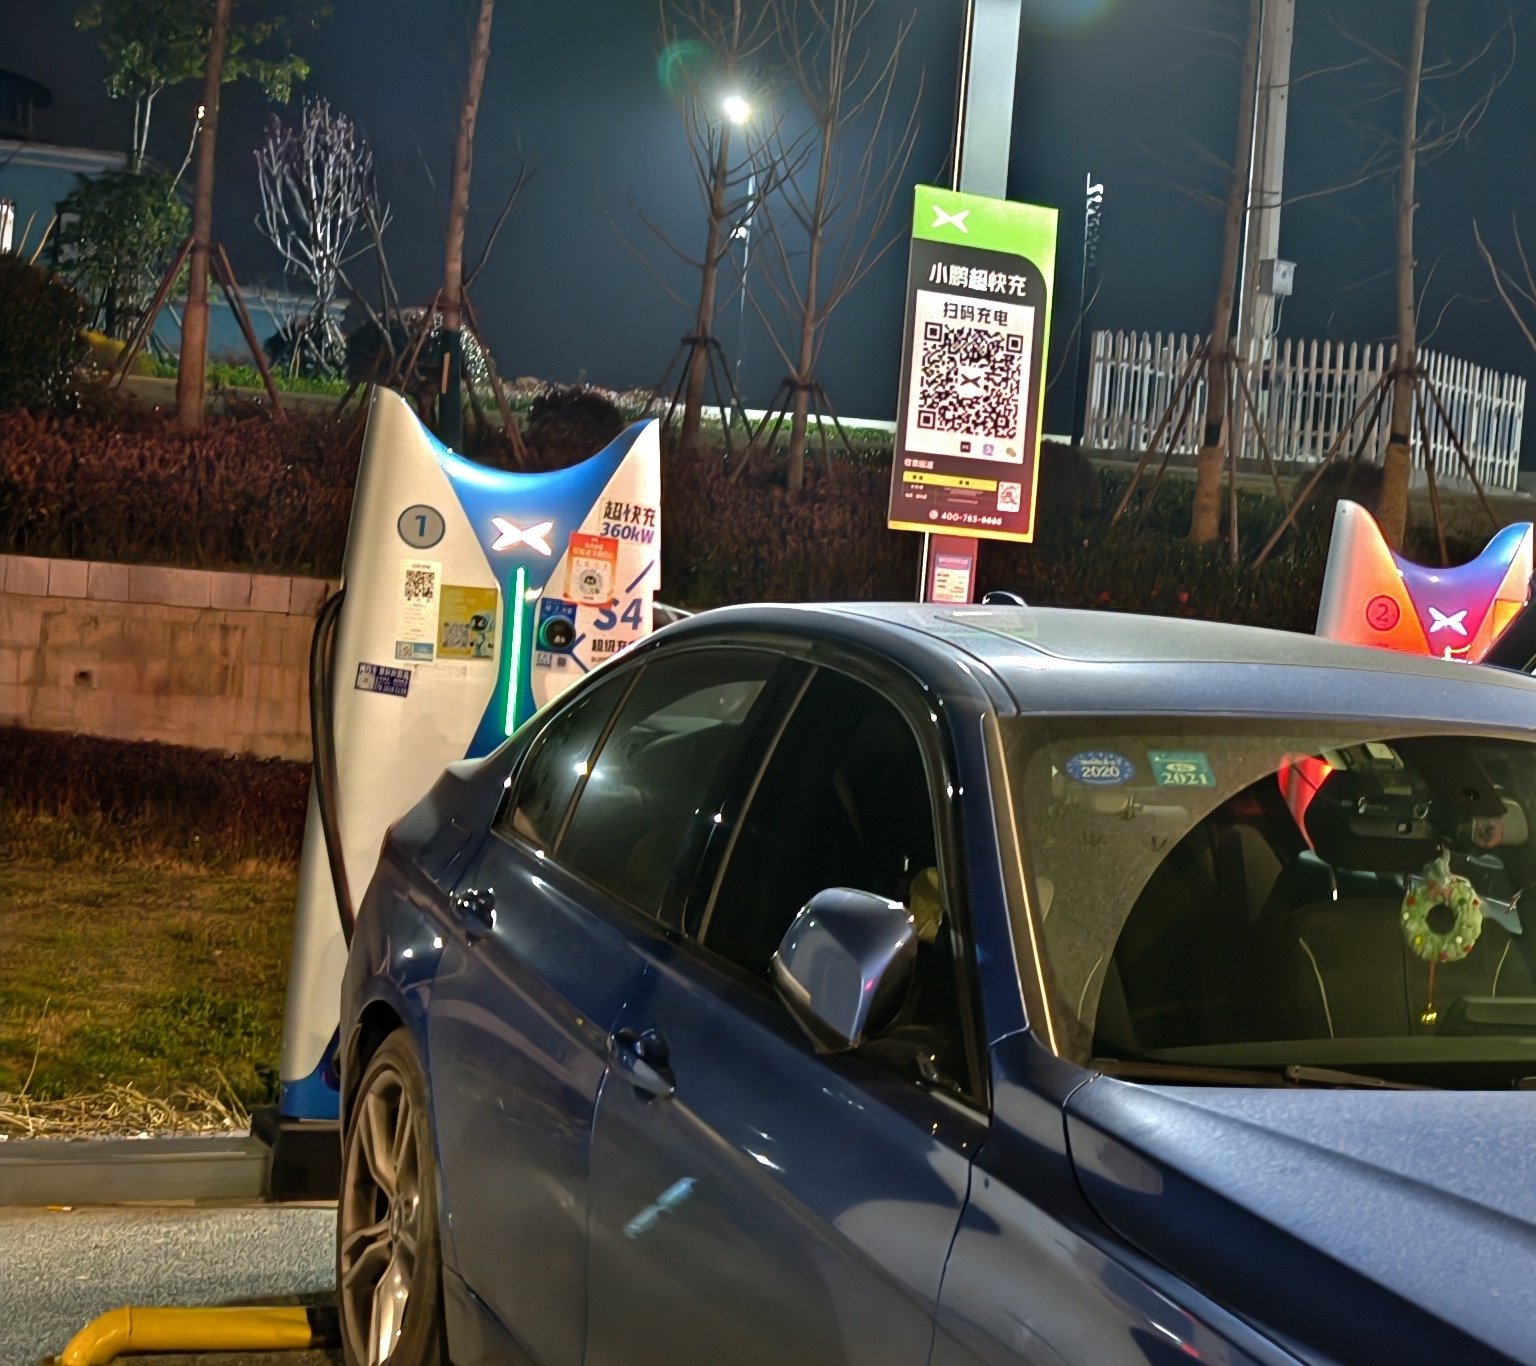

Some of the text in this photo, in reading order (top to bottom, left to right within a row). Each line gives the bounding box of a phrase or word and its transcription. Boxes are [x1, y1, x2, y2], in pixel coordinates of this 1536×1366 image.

[929, 262, 1027, 297] 小鹏超快充
[943, 301, 1008, 327] 扫码充电
[603, 500, 656, 528] 超快充
[600, 521, 655, 544] 360kW
[593, 598, 643, 631] S4
[1081, 766, 1121, 778] 2020
[1161, 772, 1208, 786] 2021
